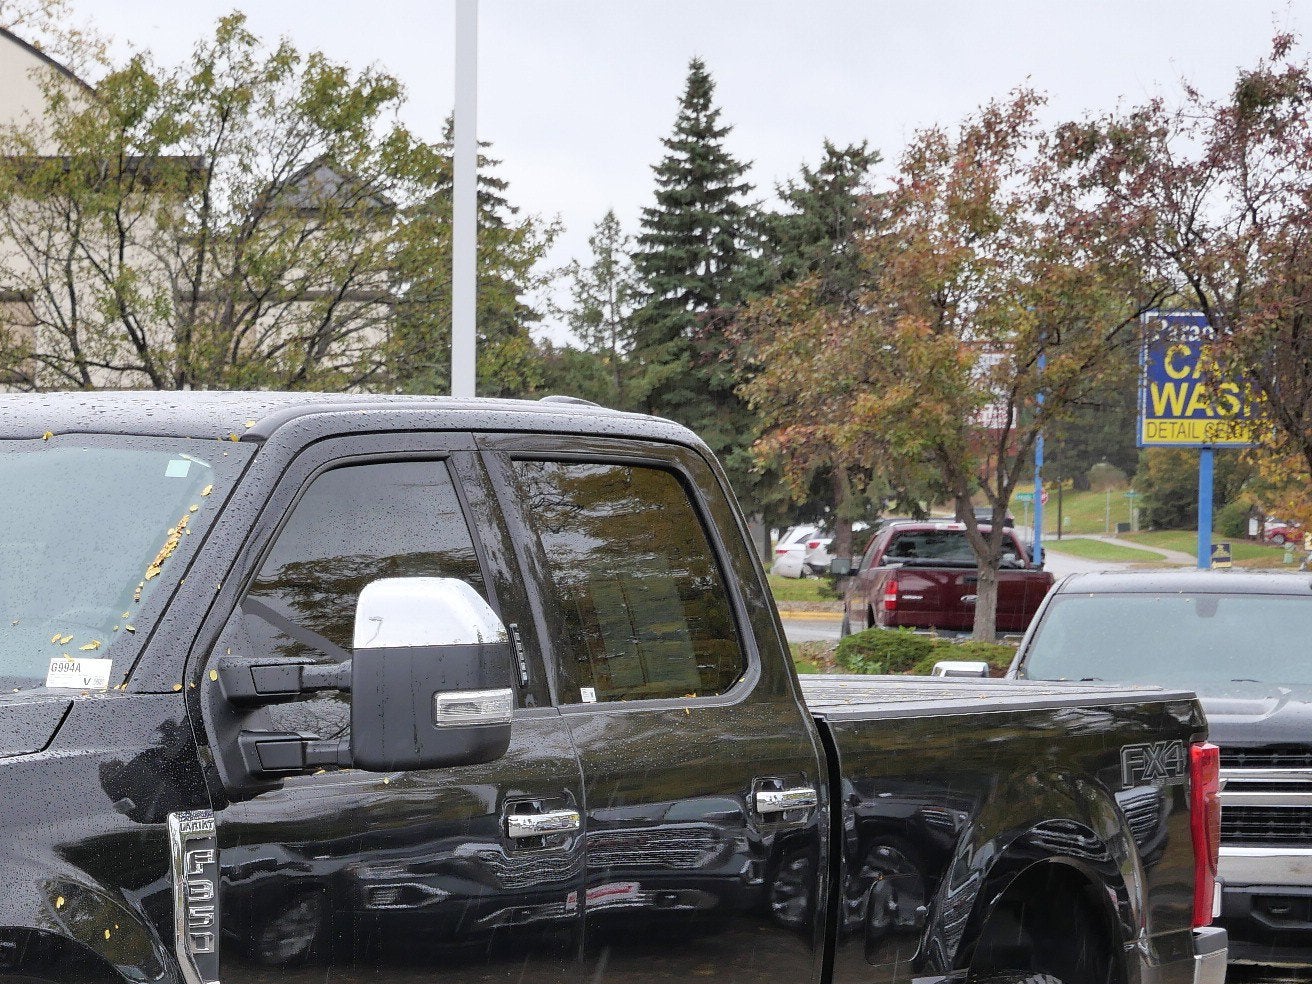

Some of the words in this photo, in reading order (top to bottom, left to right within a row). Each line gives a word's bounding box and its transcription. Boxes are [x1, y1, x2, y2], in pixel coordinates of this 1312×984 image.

[1147, 421, 1200, 439] DETAIL
[51, 662, 81, 673] G994A
[1120, 740, 1184, 788] FX4
